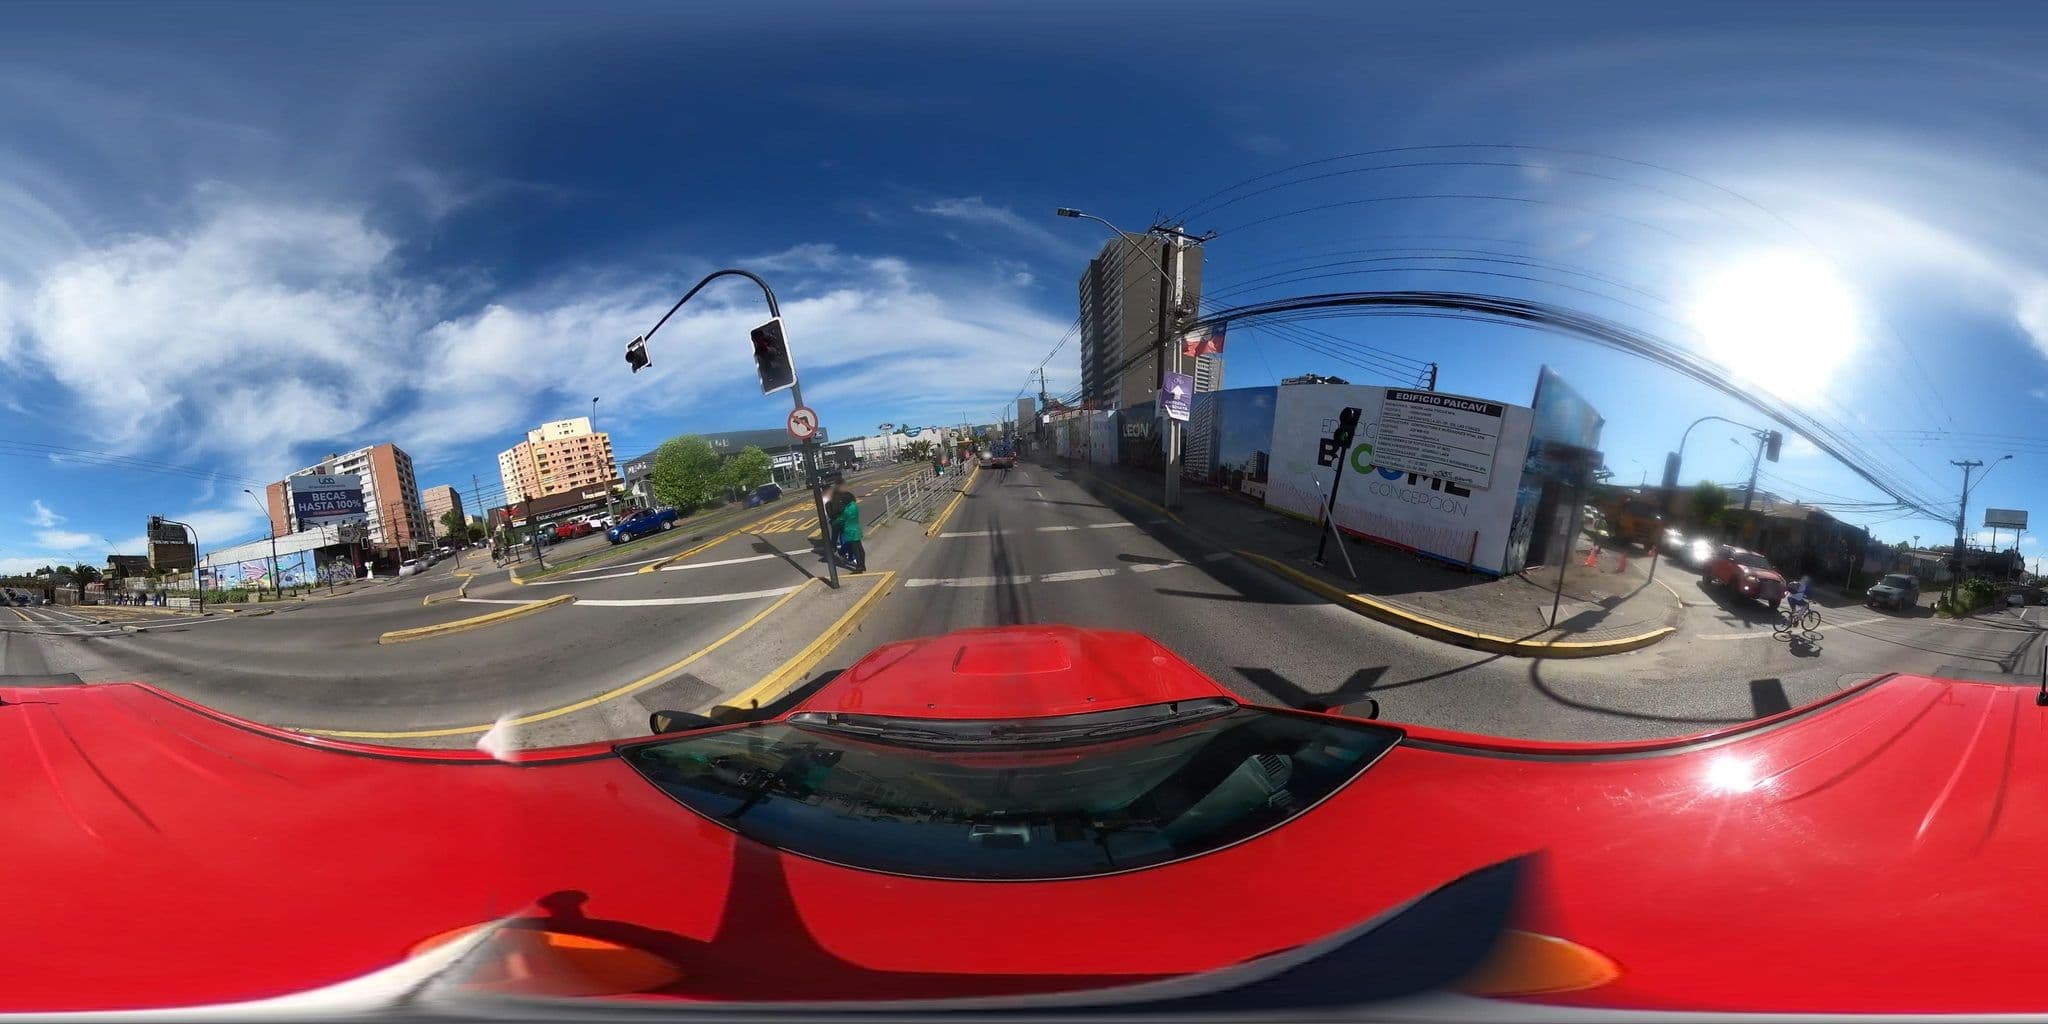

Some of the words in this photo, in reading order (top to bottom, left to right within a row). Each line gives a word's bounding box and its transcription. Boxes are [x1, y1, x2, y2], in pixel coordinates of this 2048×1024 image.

[1396, 392, 1441, 405] EDIFICIO
[1443, 399, 1487, 413] PAICAVÍ
[312, 491, 346, 501] BECAS
[298, 501, 335, 512] HASTA
[336, 499, 361, 509] 100%
